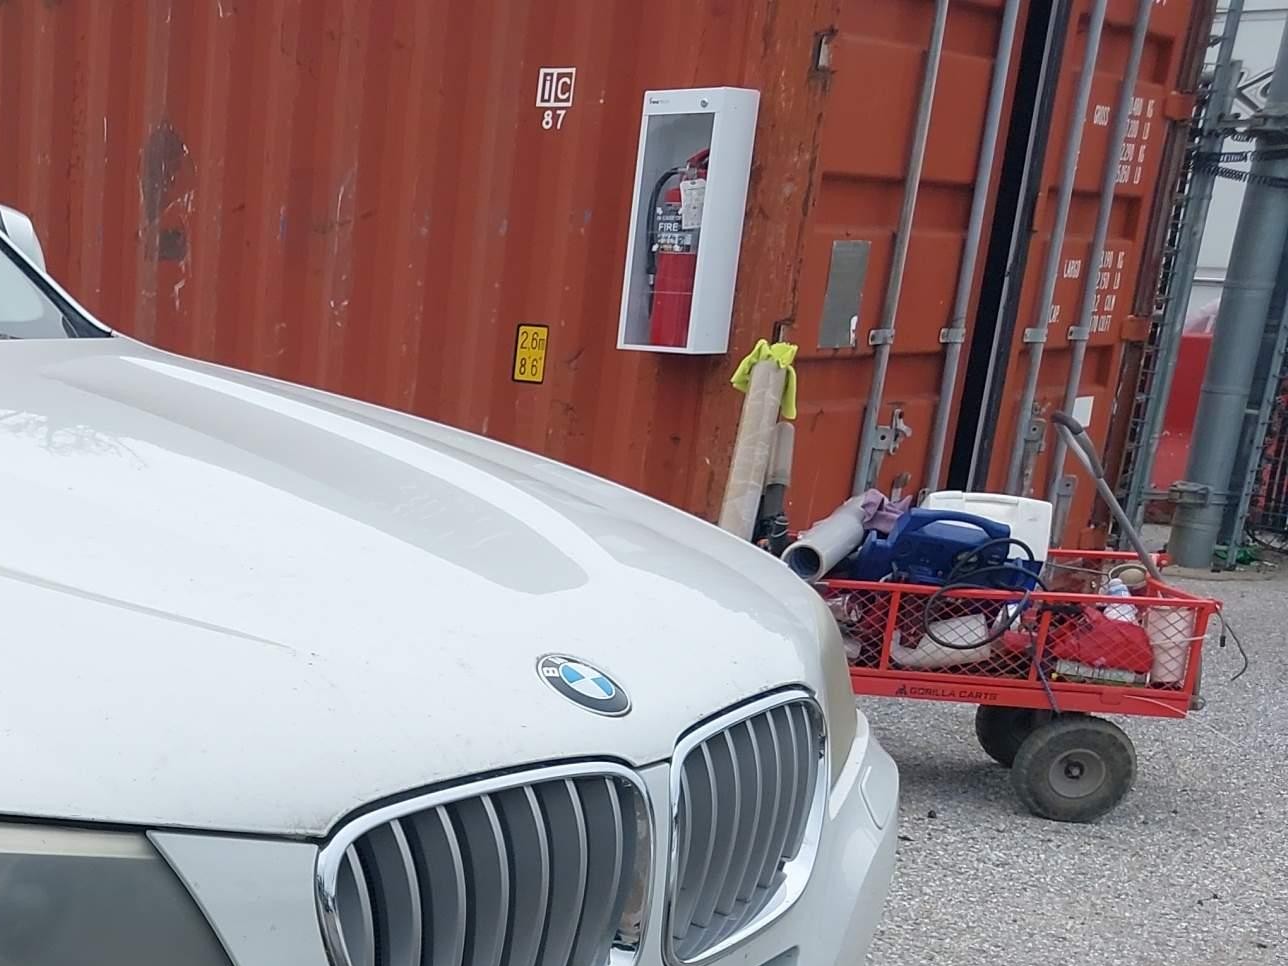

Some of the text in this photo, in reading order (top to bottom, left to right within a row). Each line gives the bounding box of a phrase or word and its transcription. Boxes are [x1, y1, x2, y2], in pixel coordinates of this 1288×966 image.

[542, 109, 566, 130] 87
[658, 222, 679, 232] FIRE
[909, 687, 999, 701] GORILLA CARTS
